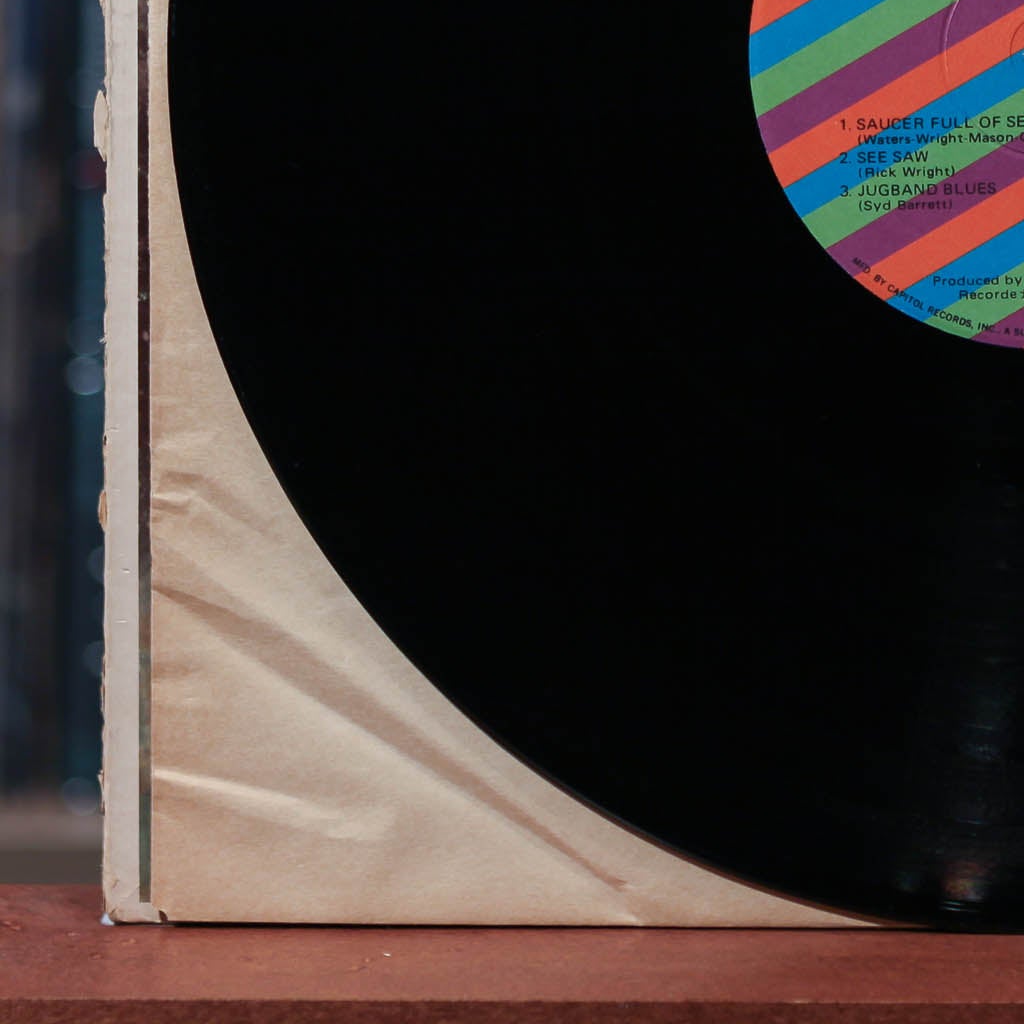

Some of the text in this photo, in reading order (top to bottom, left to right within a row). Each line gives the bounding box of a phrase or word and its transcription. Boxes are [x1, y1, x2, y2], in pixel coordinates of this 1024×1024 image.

[840, 119, 852, 131] 1.
[857, 117, 924, 131] SAUCER
[932, 116, 973, 129] FULL
[979, 116, 1001, 129] OF
[840, 151, 929, 164] 2. SEE SAW
[859, 166, 956, 180] (Rick Wright)
[840, 182, 997, 198] 3. JUGBAND BLUES
[859, 200, 953, 212] (Syd Barrett)
[933, 275, 1000, 287] Produced
[1005, 275, 1022, 286] by
[874, 274, 887, 286] BY
[887, 284, 925, 310] CAPITOL
[928, 305, 974, 329] RECORDS,
